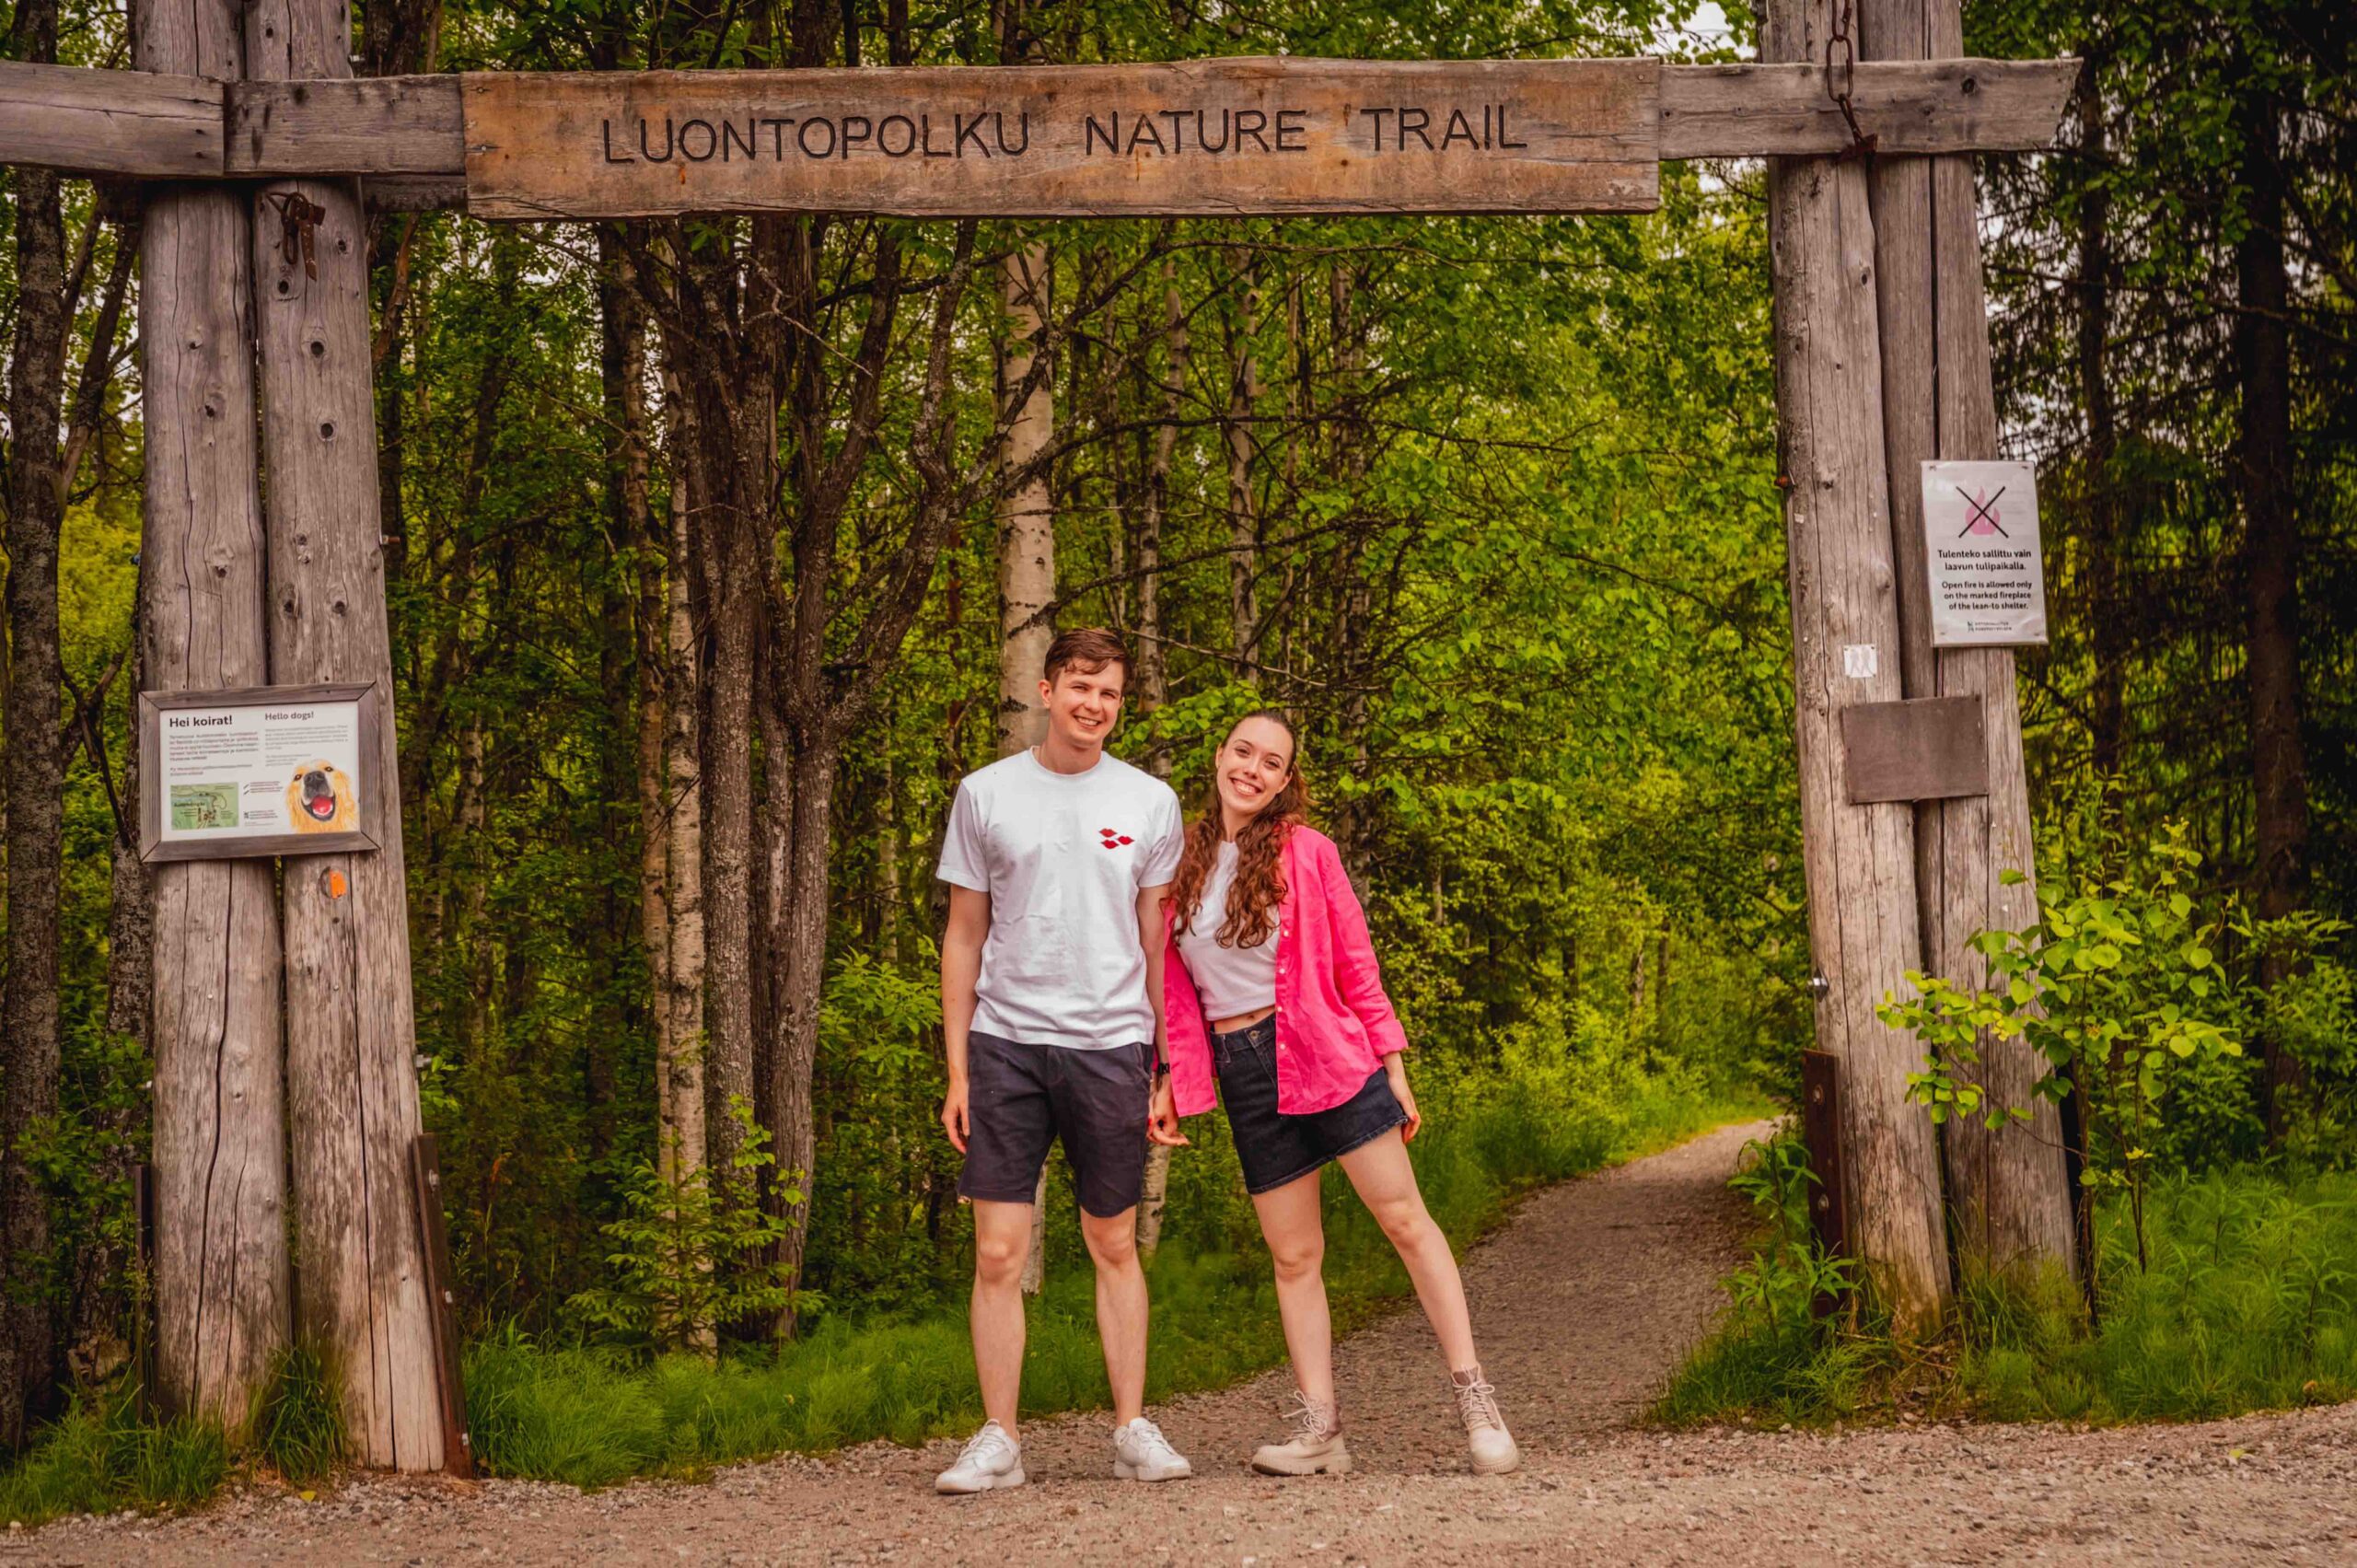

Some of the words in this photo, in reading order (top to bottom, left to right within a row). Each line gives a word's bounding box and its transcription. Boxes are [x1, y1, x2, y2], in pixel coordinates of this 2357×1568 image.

[603, 112, 1028, 164] LUONTOPOLKU
[1086, 109, 1307, 156] NATURE
[1361, 105, 1528, 152] TRAIL
[1937, 550, 1980, 558] Tulenteko
[1982, 549, 2012, 558] sallittu
[2014, 549, 2031, 558] vain
[1945, 563, 1973, 571] laavun
[1976, 563, 2026, 572] tulipaikalla.
[1942, 581, 1963, 589] Open
[2016, 581, 2032, 589] only
[290, 711, 314, 721] dogs!
[169, 717, 189, 727] Hei
[193, 715, 232, 727] koirat!
